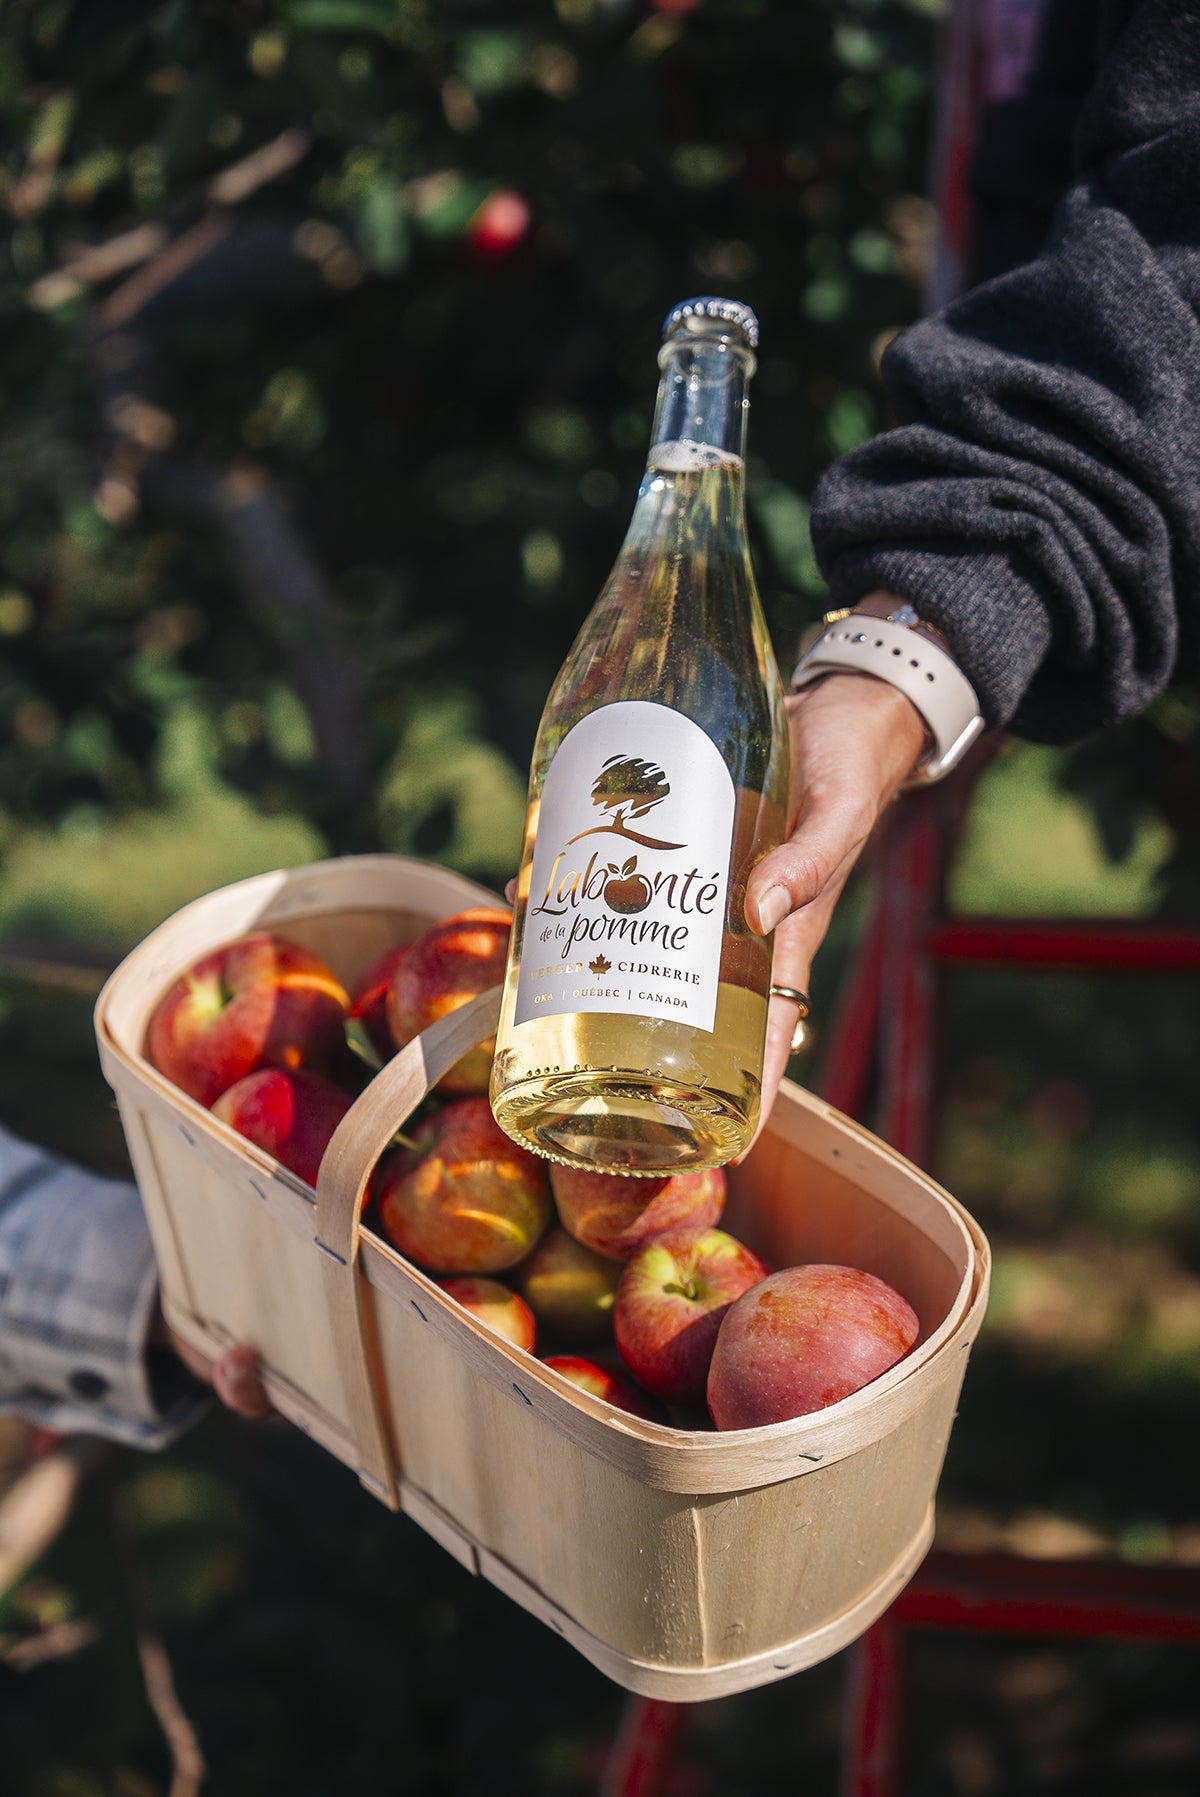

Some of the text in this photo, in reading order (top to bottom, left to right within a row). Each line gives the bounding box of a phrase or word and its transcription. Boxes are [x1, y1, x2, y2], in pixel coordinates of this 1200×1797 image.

[540, 913, 689, 959] de la pomme
[618, 961, 700, 985] CIDRERIE
[534, 988, 688, 1008] OKA QUÉBEC CANADA
